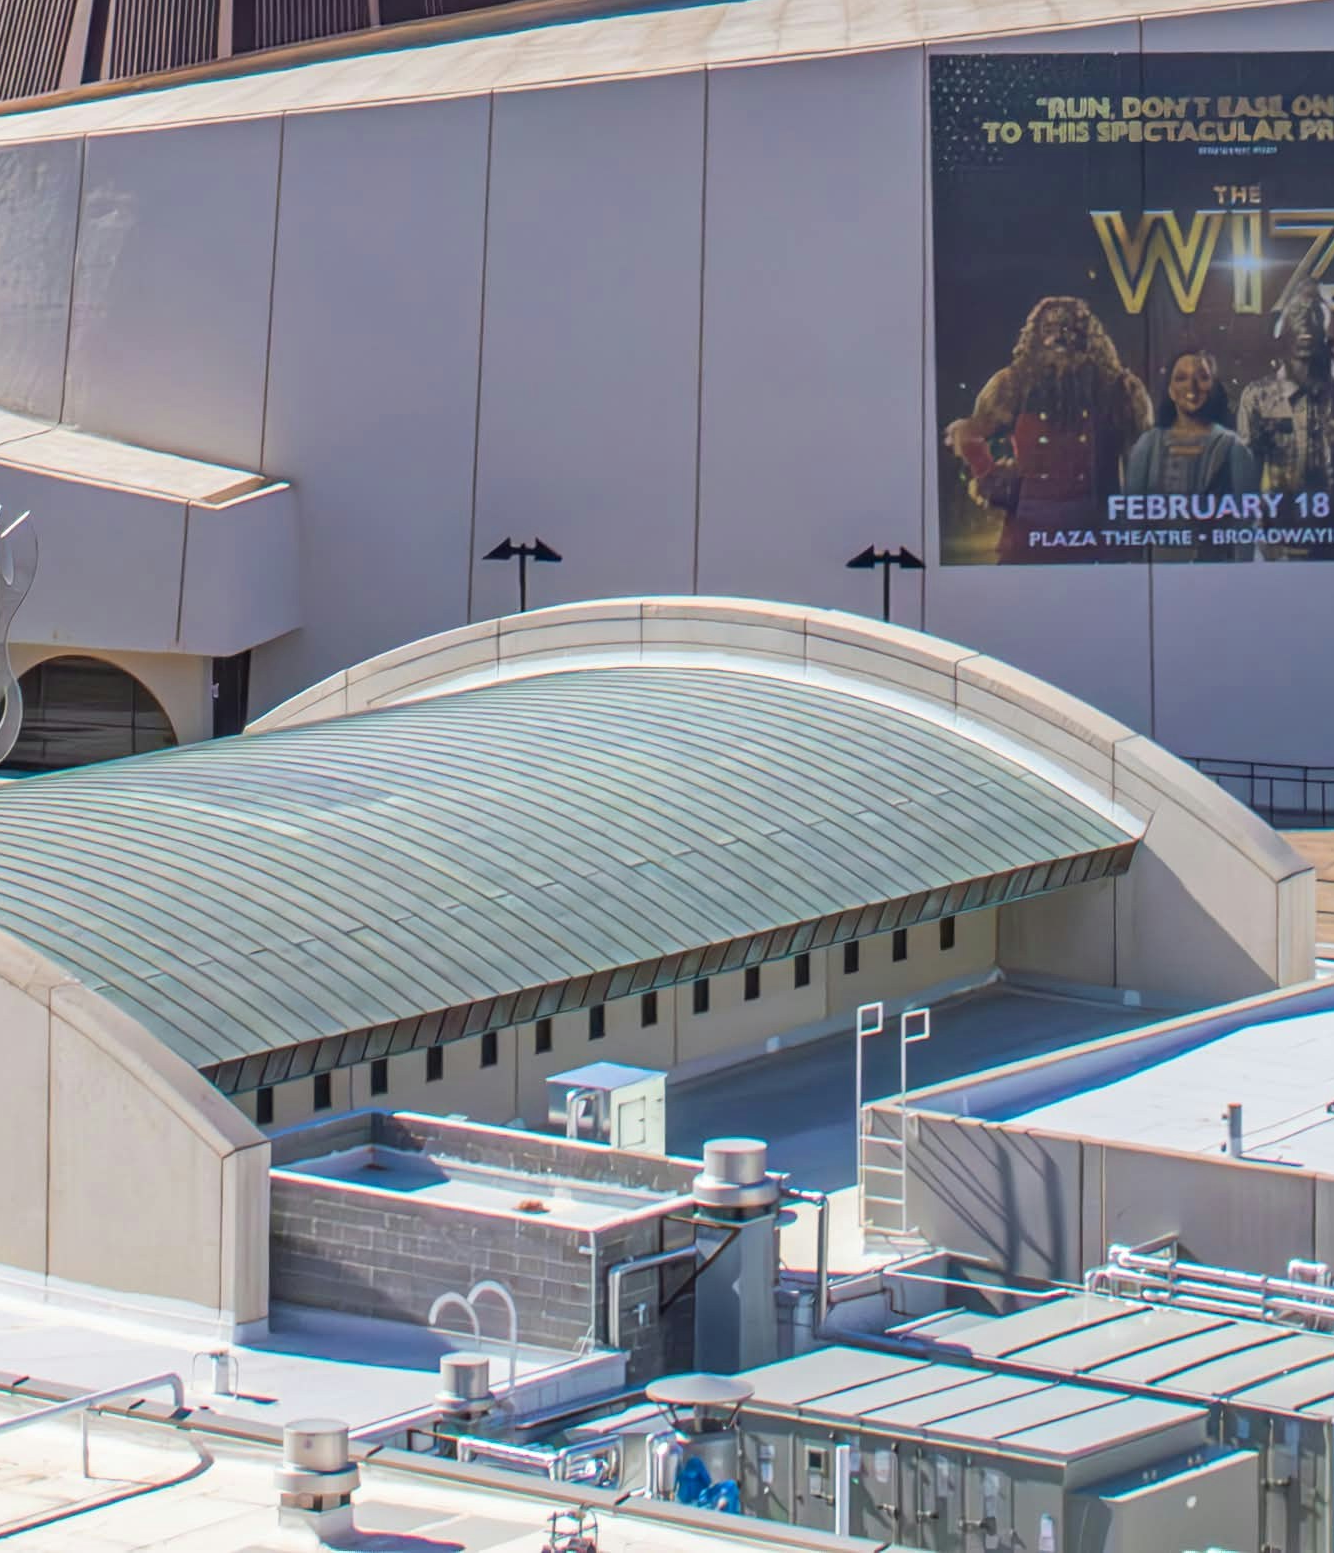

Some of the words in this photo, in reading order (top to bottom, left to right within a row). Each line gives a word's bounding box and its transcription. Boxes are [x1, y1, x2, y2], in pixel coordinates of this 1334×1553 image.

[1218, 96, 1288, 119] EASE
[981, 122, 1023, 143] TO
[1028, 121, 1090, 143] THIS
[1096, 120, 1295, 143] SPECTACULAR
[1213, 184, 1262, 204] THE
[1107, 493, 1284, 521] FEBRUARY
[1295, 492, 1330, 519] 18
[1029, 530, 1097, 547] PLAZA
[1101, 529, 1192, 546] THEATRE
